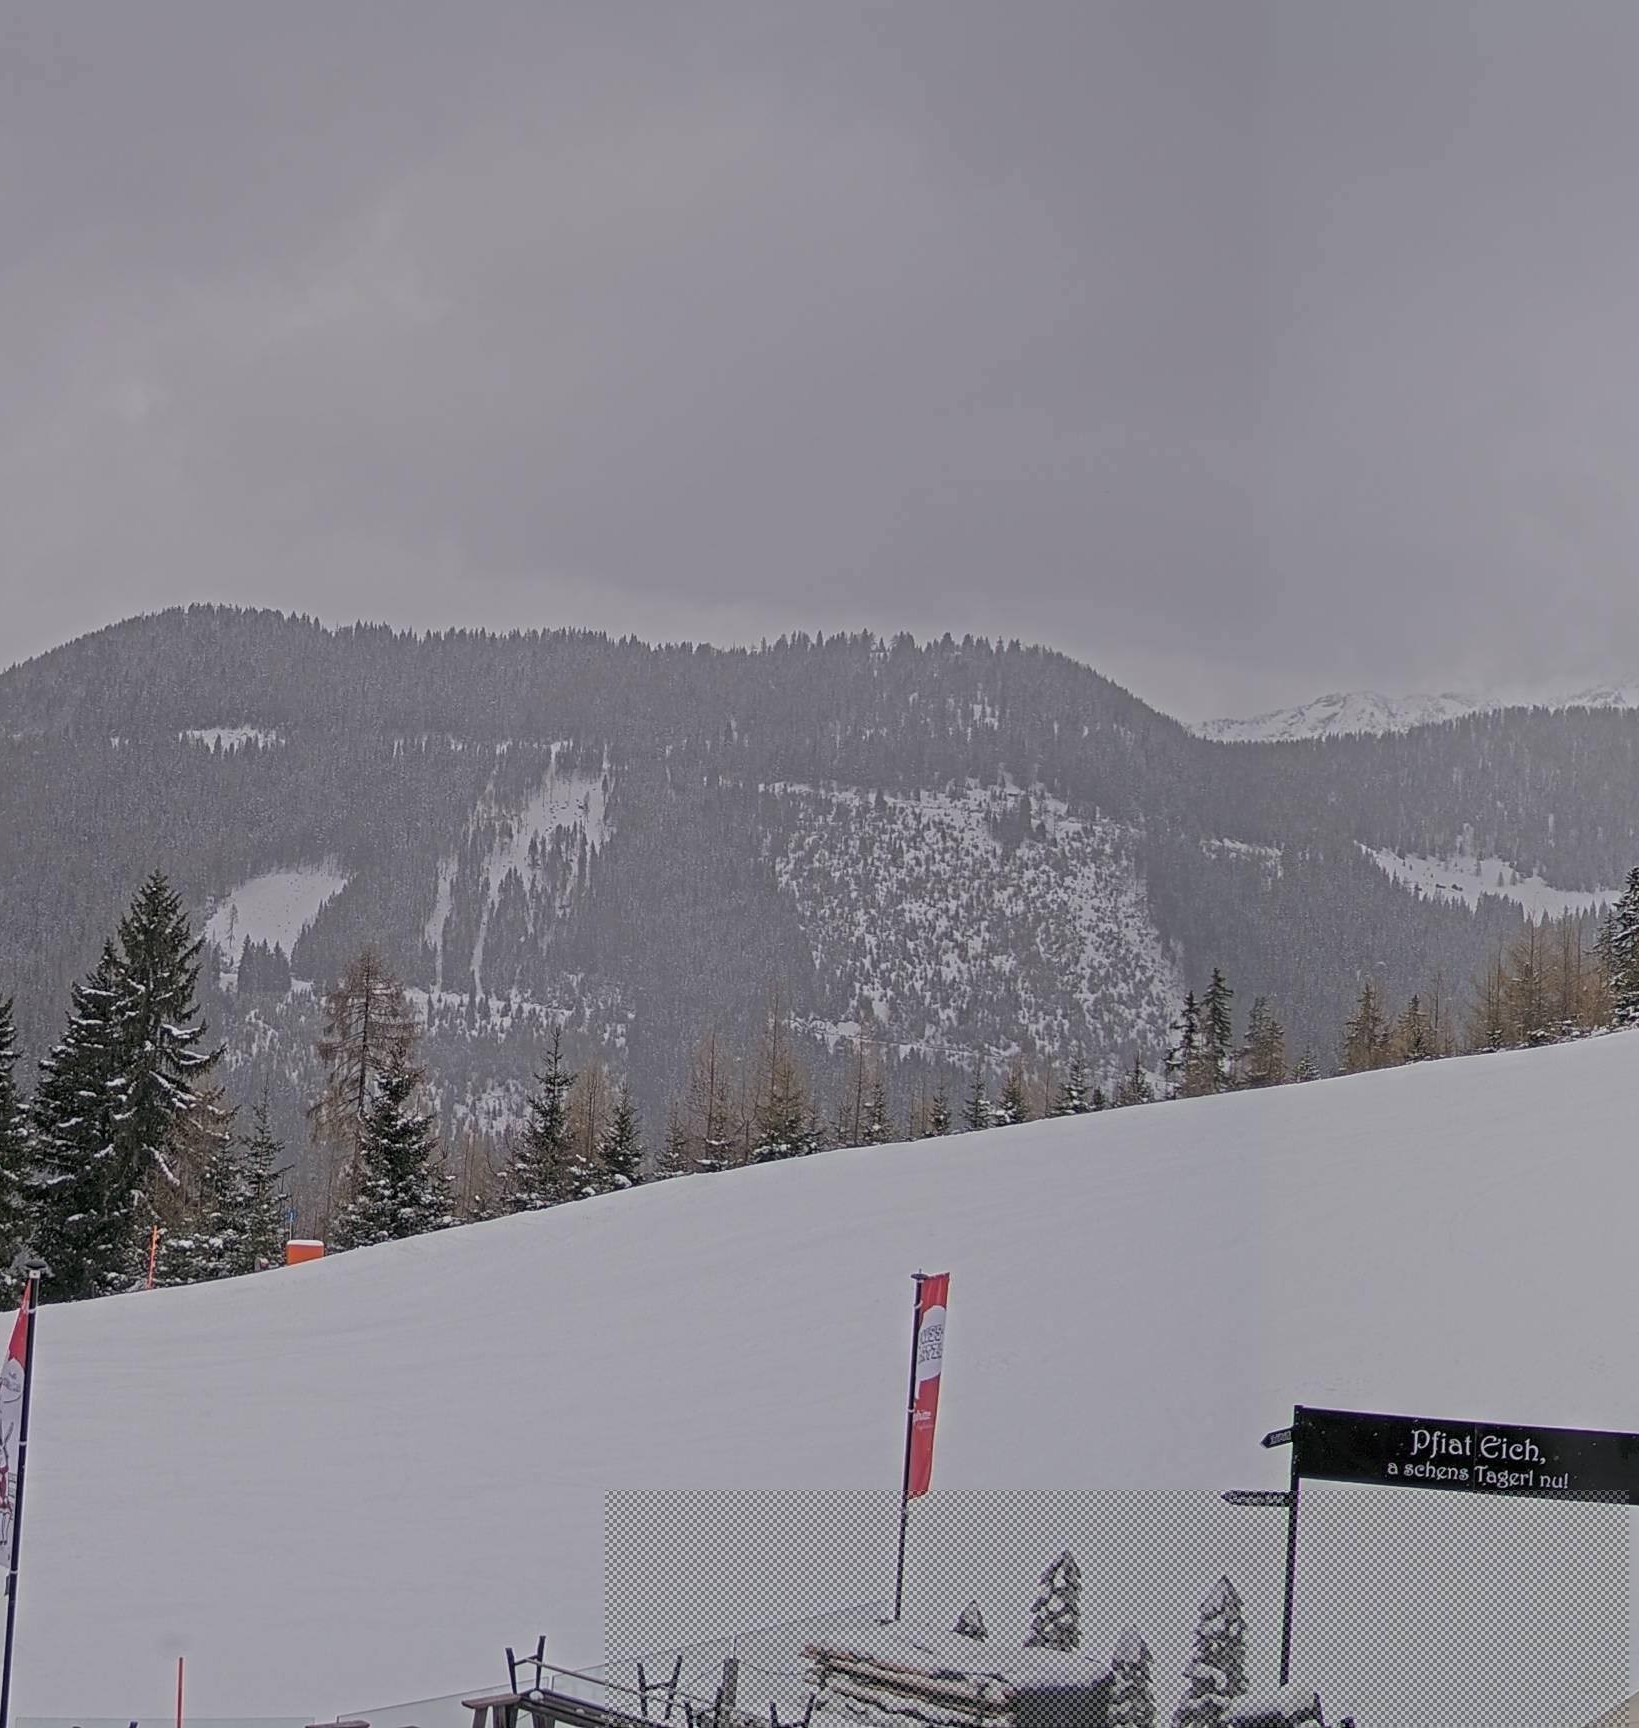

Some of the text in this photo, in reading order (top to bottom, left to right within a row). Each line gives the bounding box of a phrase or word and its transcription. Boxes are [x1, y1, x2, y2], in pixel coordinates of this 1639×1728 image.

[1410, 1429, 1547, 1465] Pfiat Eich,
[1387, 1461, 1569, 1489] a schens Tagerl nu!
